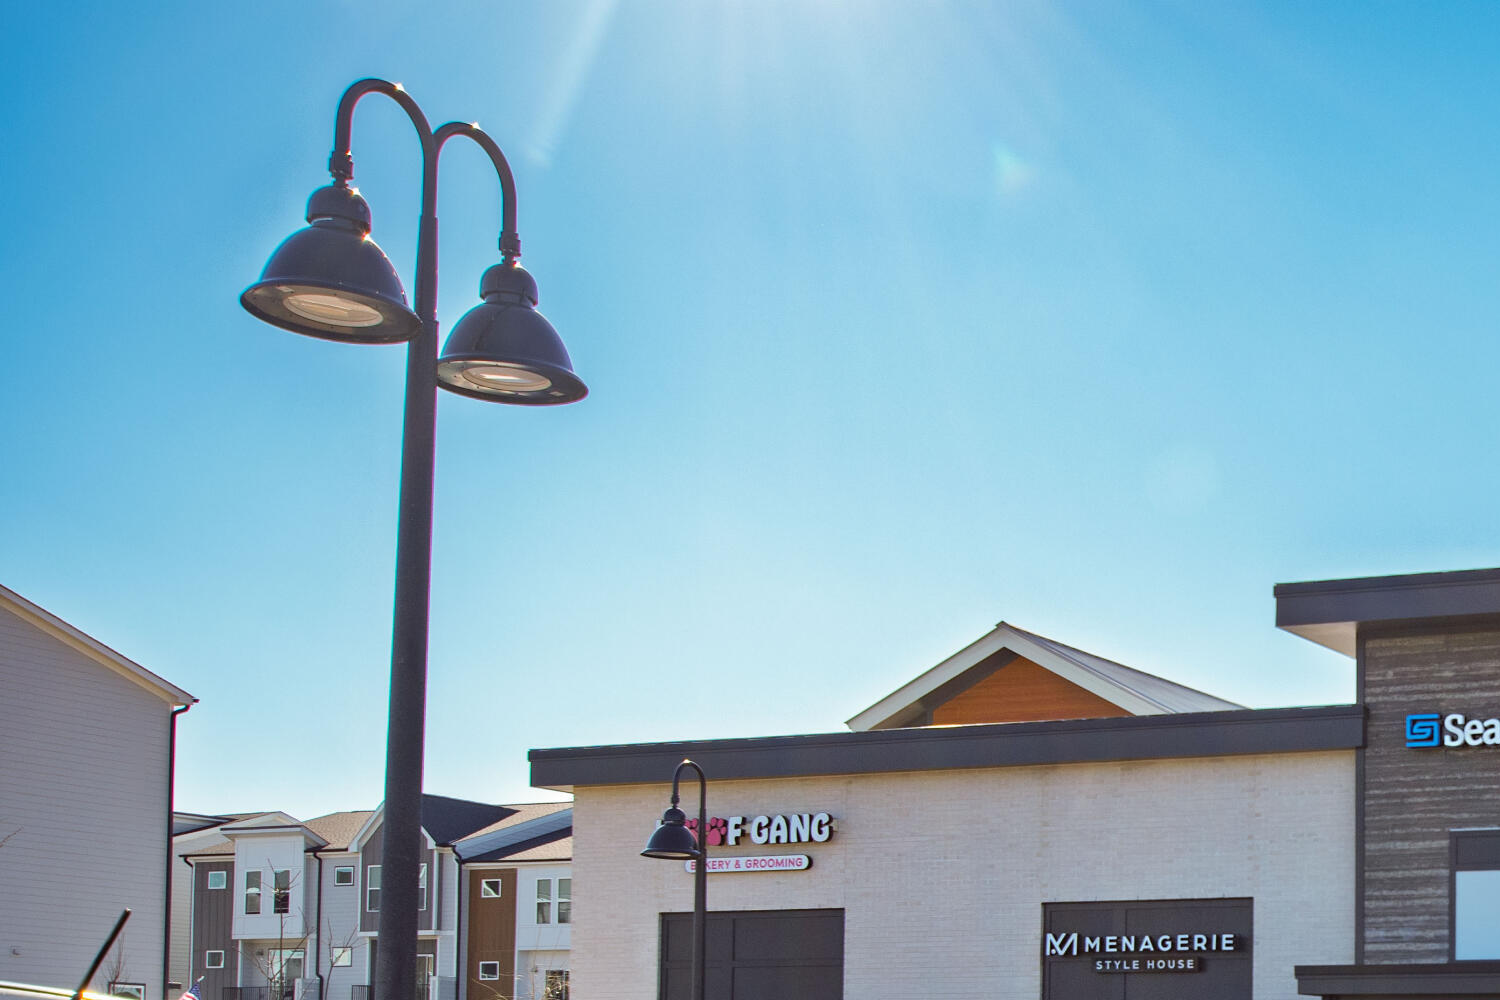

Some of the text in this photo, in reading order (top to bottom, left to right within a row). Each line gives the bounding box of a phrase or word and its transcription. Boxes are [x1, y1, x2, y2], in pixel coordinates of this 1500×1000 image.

[750, 812, 831, 845] GANG
[690, 857, 803, 871] BKERY & GROOMING
[1084, 934, 1235, 953] MENAGERIE
[1095, 959, 1195, 970] STYLE HOUSE
